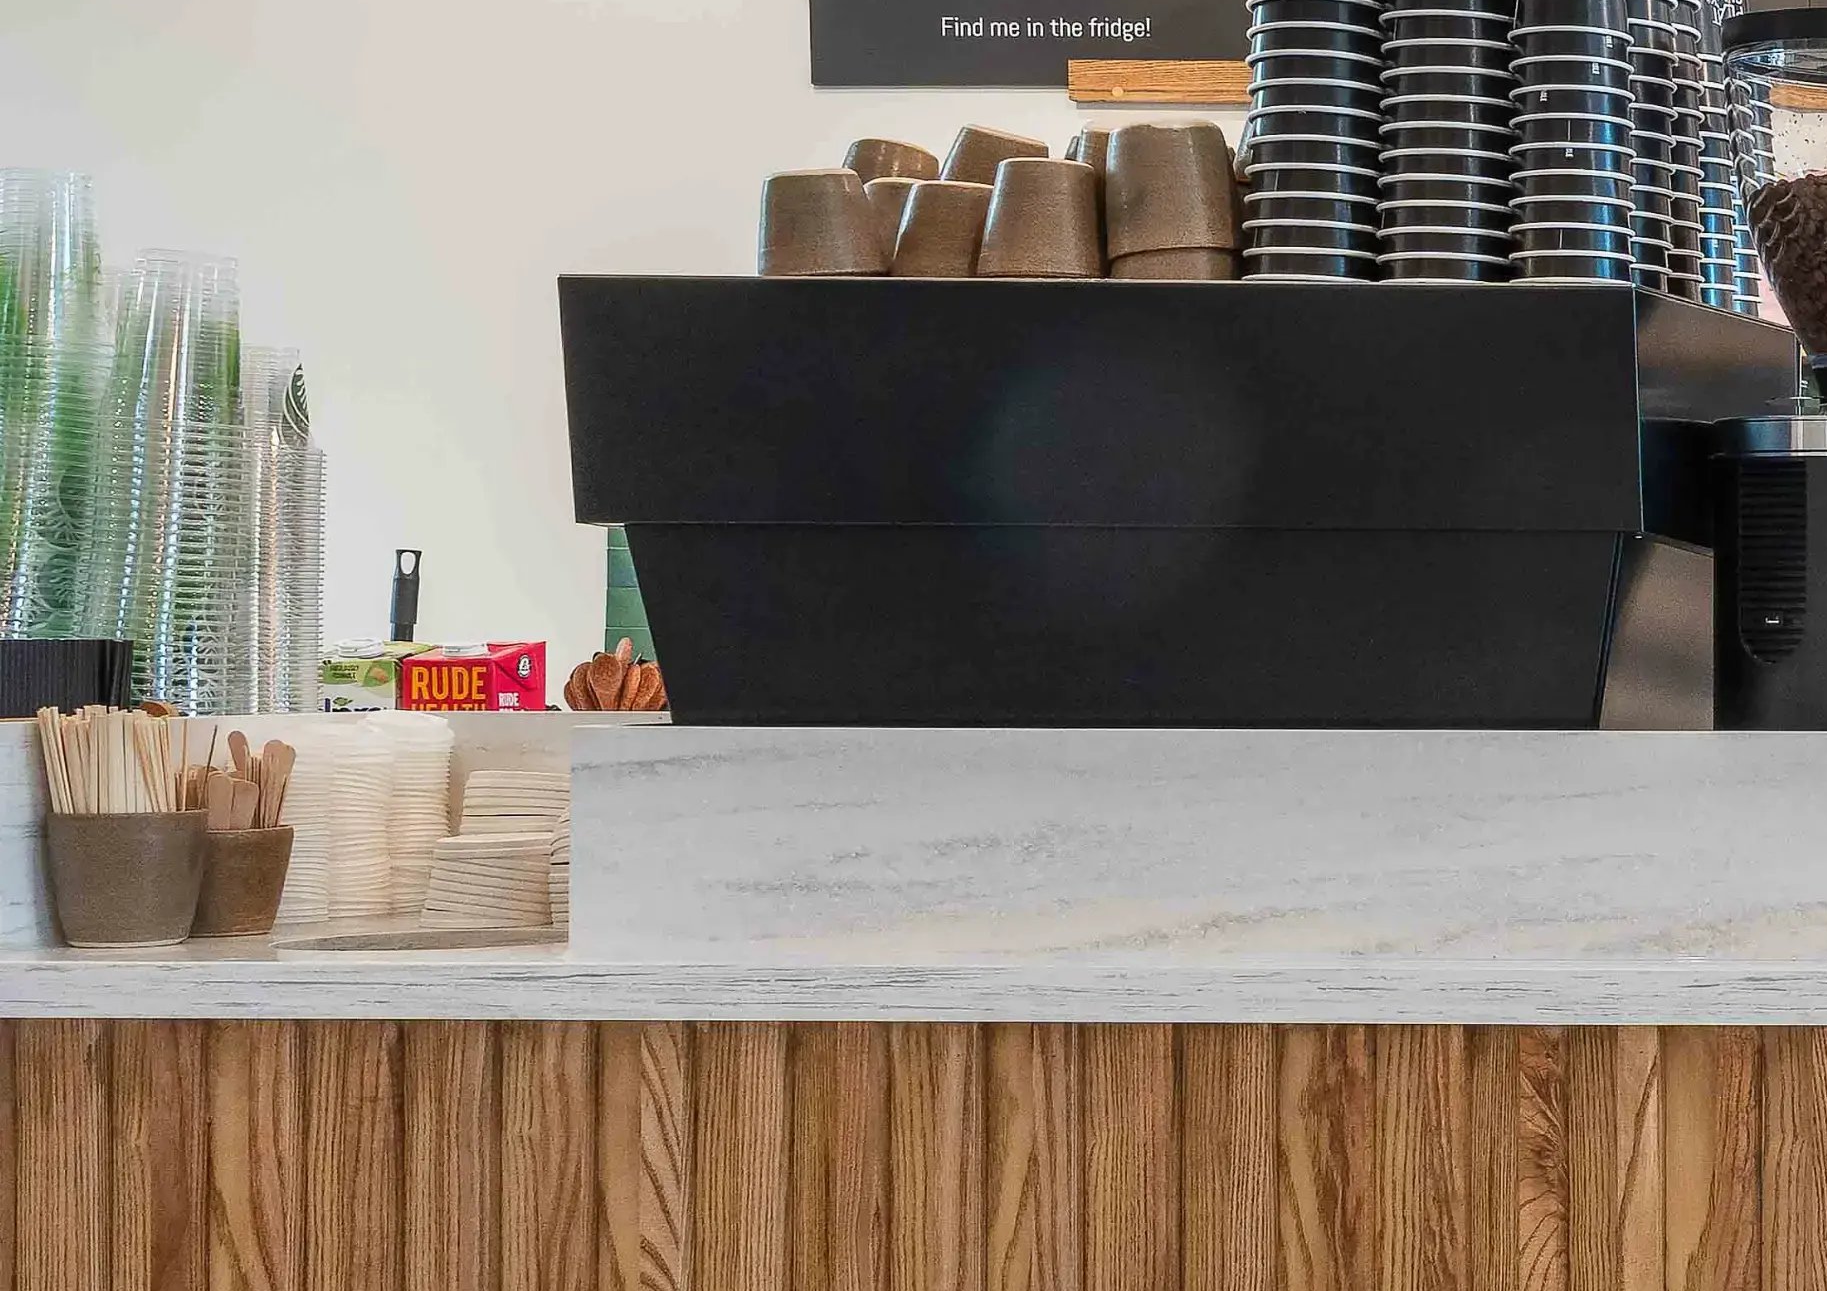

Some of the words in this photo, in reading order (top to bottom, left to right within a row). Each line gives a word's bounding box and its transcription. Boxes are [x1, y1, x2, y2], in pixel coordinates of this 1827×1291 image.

[942, 17, 982, 36] Find
[991, 22, 1019, 36] me
[1027, 18, 1043, 36] in
[1050, 18, 1082, 36] the
[1088, 18, 1150, 41] fridge!
[412, 666, 487, 700] RUDE
